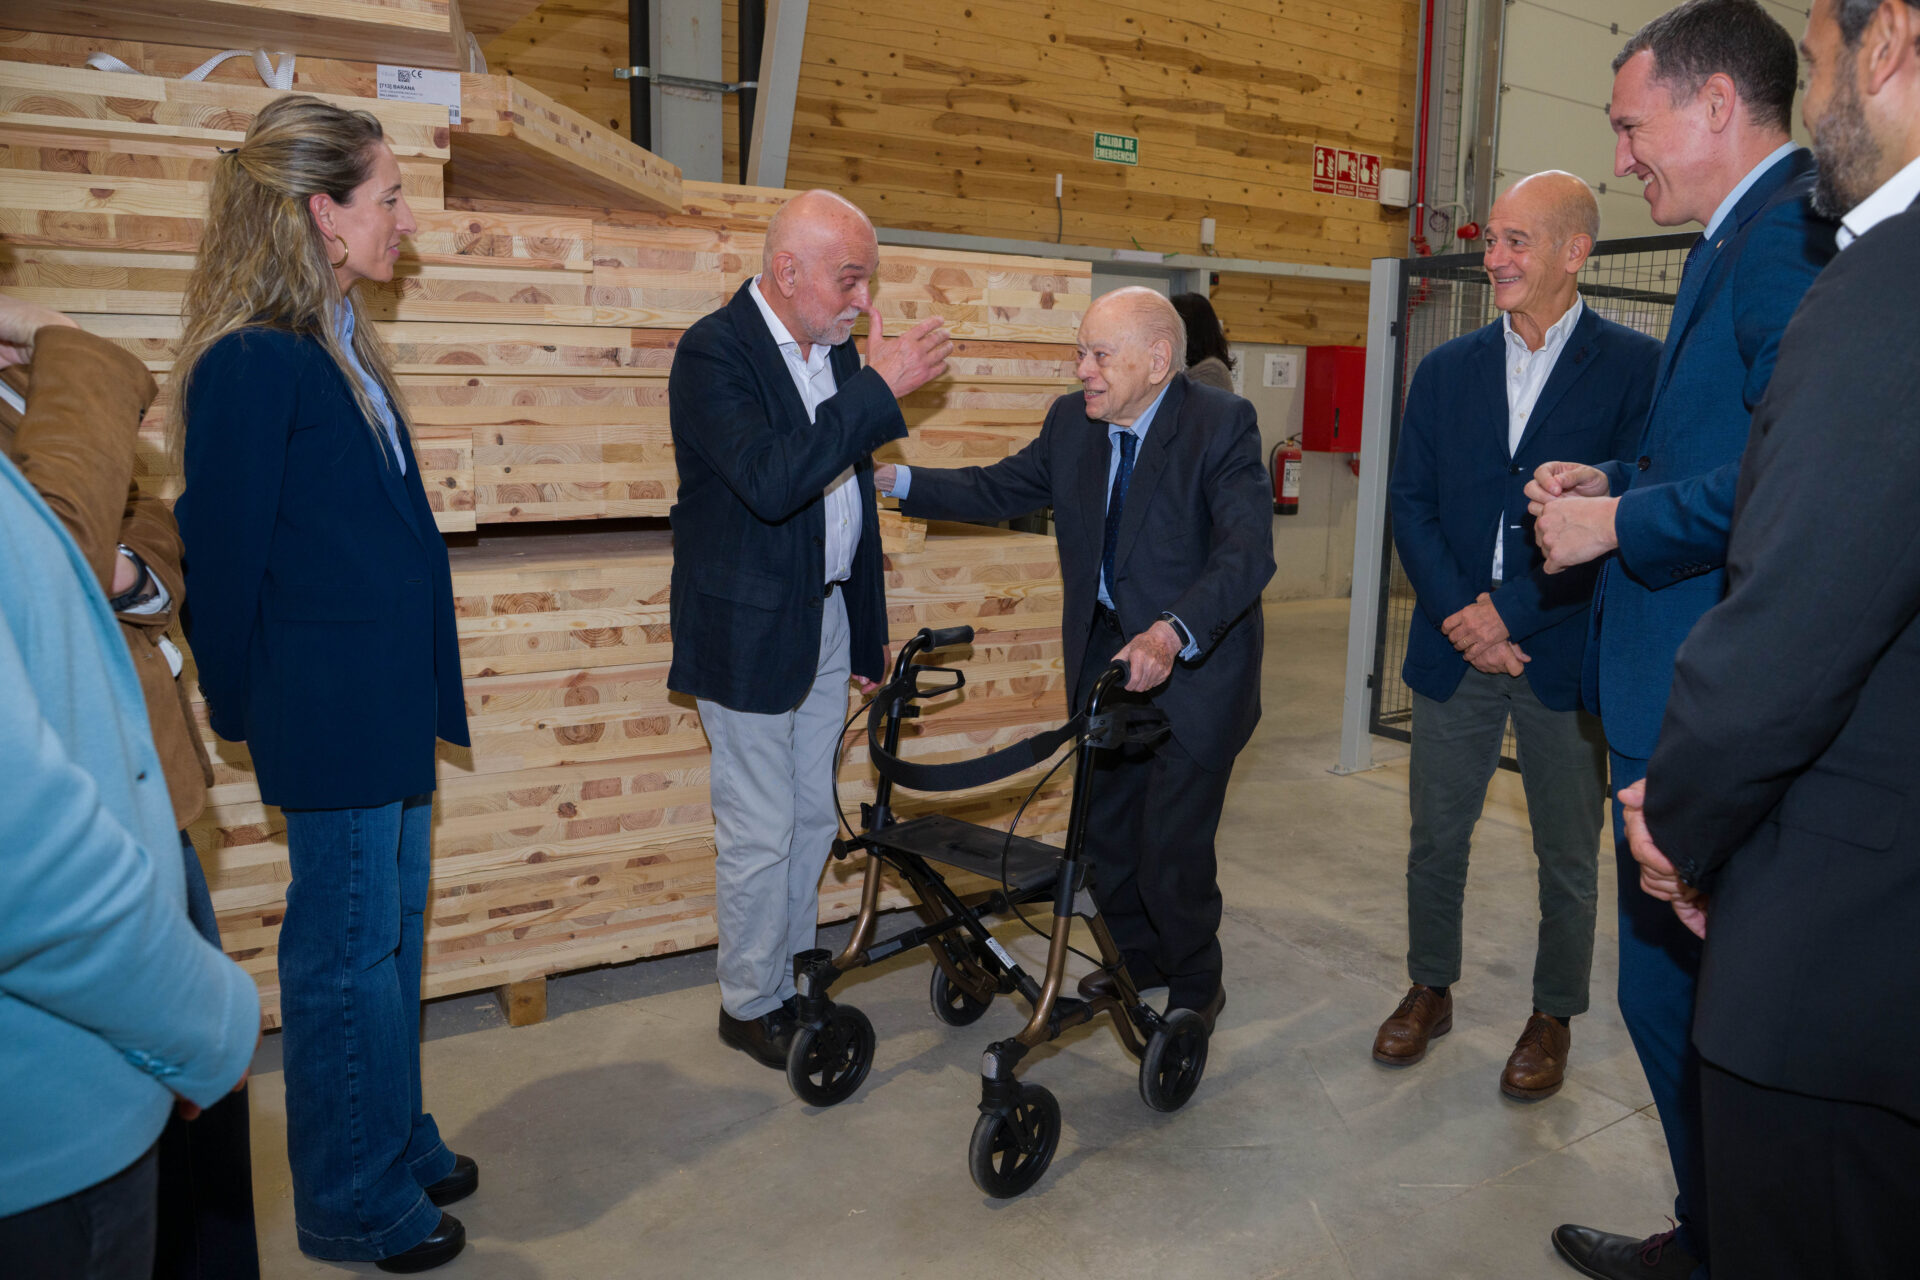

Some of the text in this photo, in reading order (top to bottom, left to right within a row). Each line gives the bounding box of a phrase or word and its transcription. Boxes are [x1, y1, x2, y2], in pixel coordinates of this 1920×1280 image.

[411, 69, 423, 79] CE
[1099, 135, 1134, 150] SALIDA DE
[1096, 147, 1136, 162] EMERGENCIA
